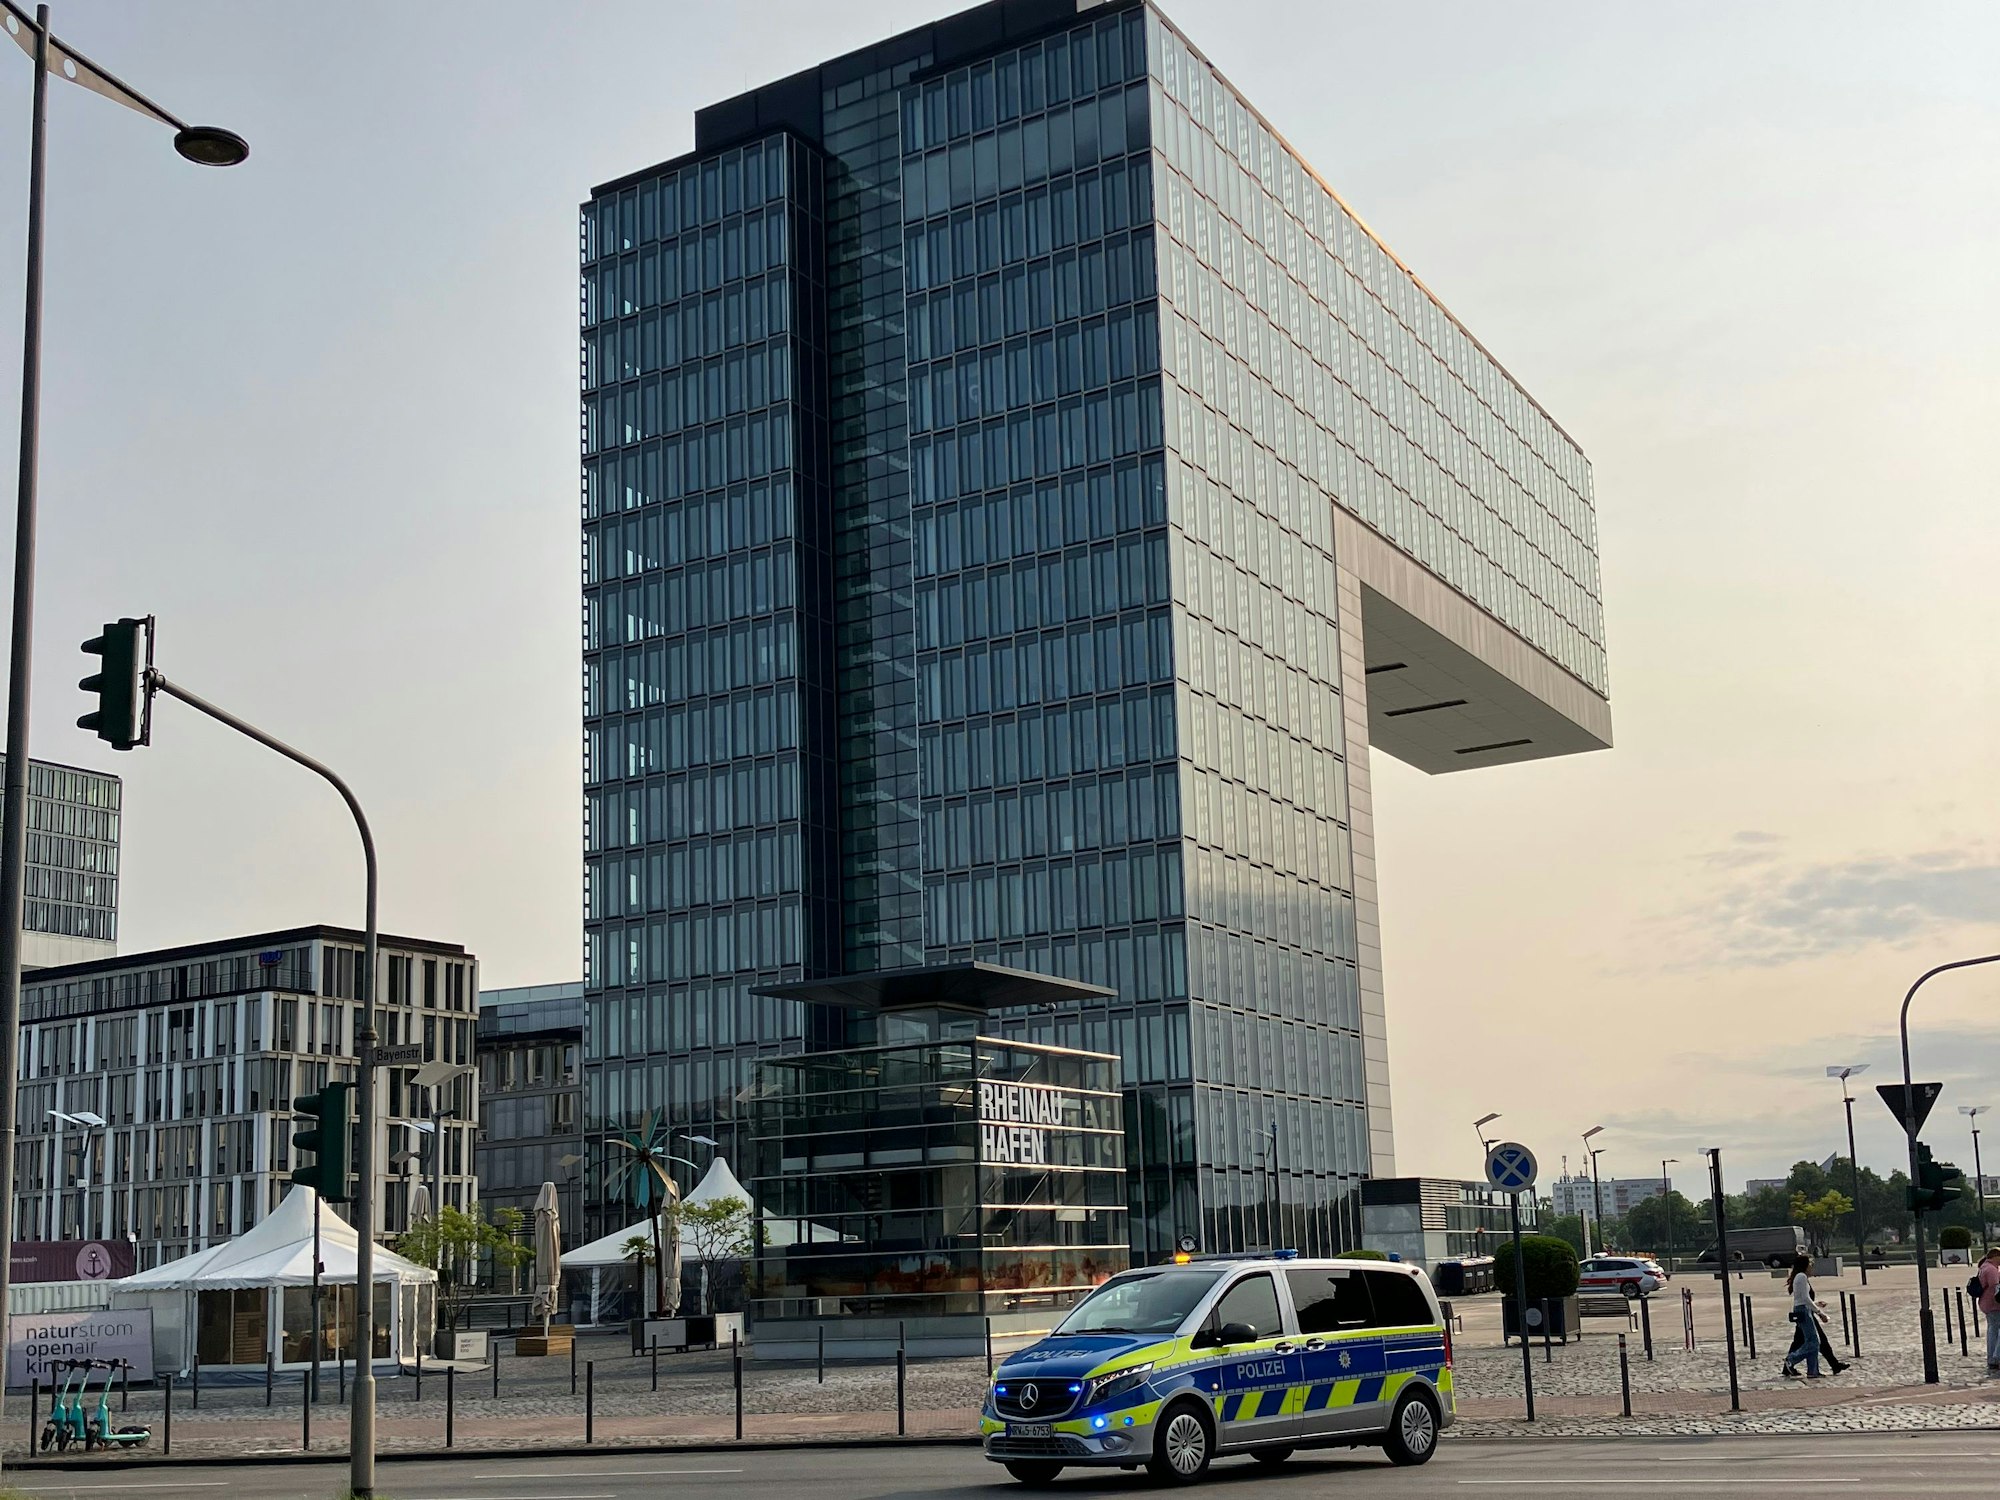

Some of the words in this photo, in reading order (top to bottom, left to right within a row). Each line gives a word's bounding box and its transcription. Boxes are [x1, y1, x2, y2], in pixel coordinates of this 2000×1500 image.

[377, 1049, 421, 1062] Bayenstr.
[980, 1083, 1063, 1125] RHEINAU
[982, 1125, 1045, 1164] HAFEN
[26, 1323, 133, 1340] naturstrom
[26, 1339, 98, 1358] openair
[1022, 1350, 1093, 1360] POLIZEI
[26, 1359, 67, 1374] kino
[1237, 1360, 1286, 1380] POLIZEI
